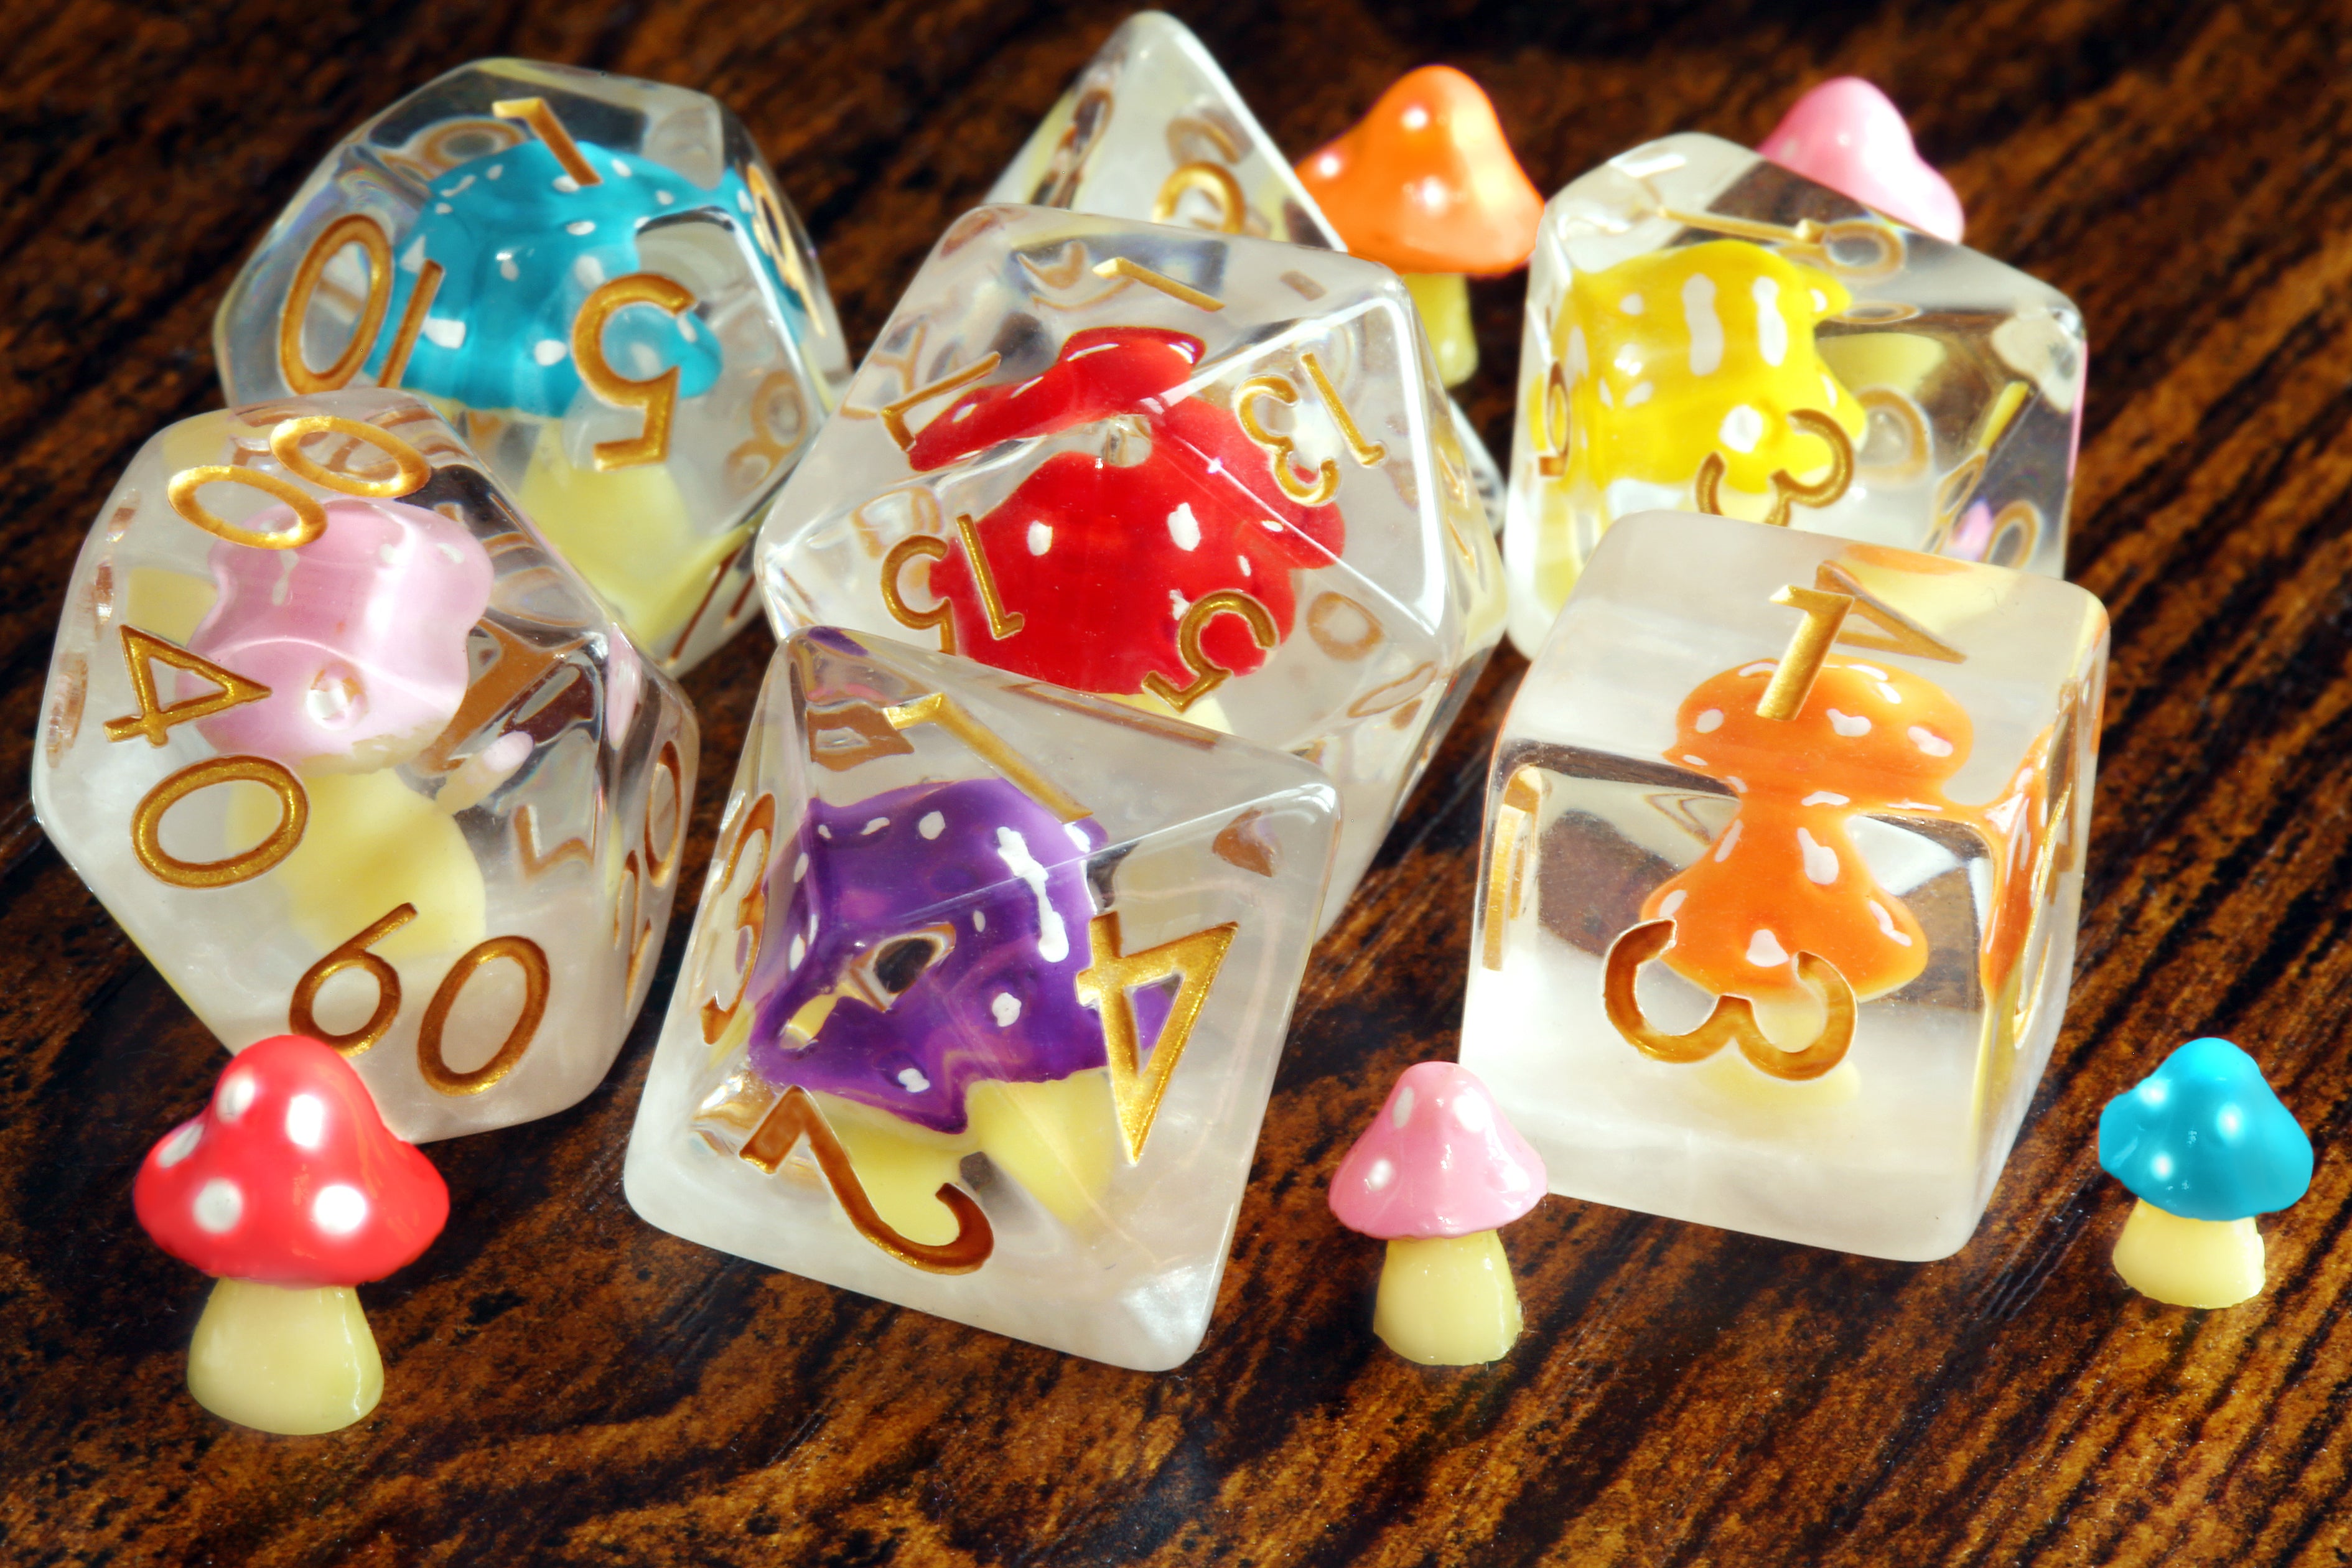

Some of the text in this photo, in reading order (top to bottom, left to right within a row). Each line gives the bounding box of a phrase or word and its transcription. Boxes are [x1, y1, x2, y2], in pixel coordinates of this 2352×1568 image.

[572, 273, 699, 471] 5
[1234, 352, 1386, 506] 13
[880, 513, 1025, 653] 15
[1141, 589, 1281, 712] 5
[102, 624, 310, 889] 40
[289, 902, 551, 1097] 60
[1075, 910, 1239, 1165] 4
[1603, 918, 1858, 1081] 3
